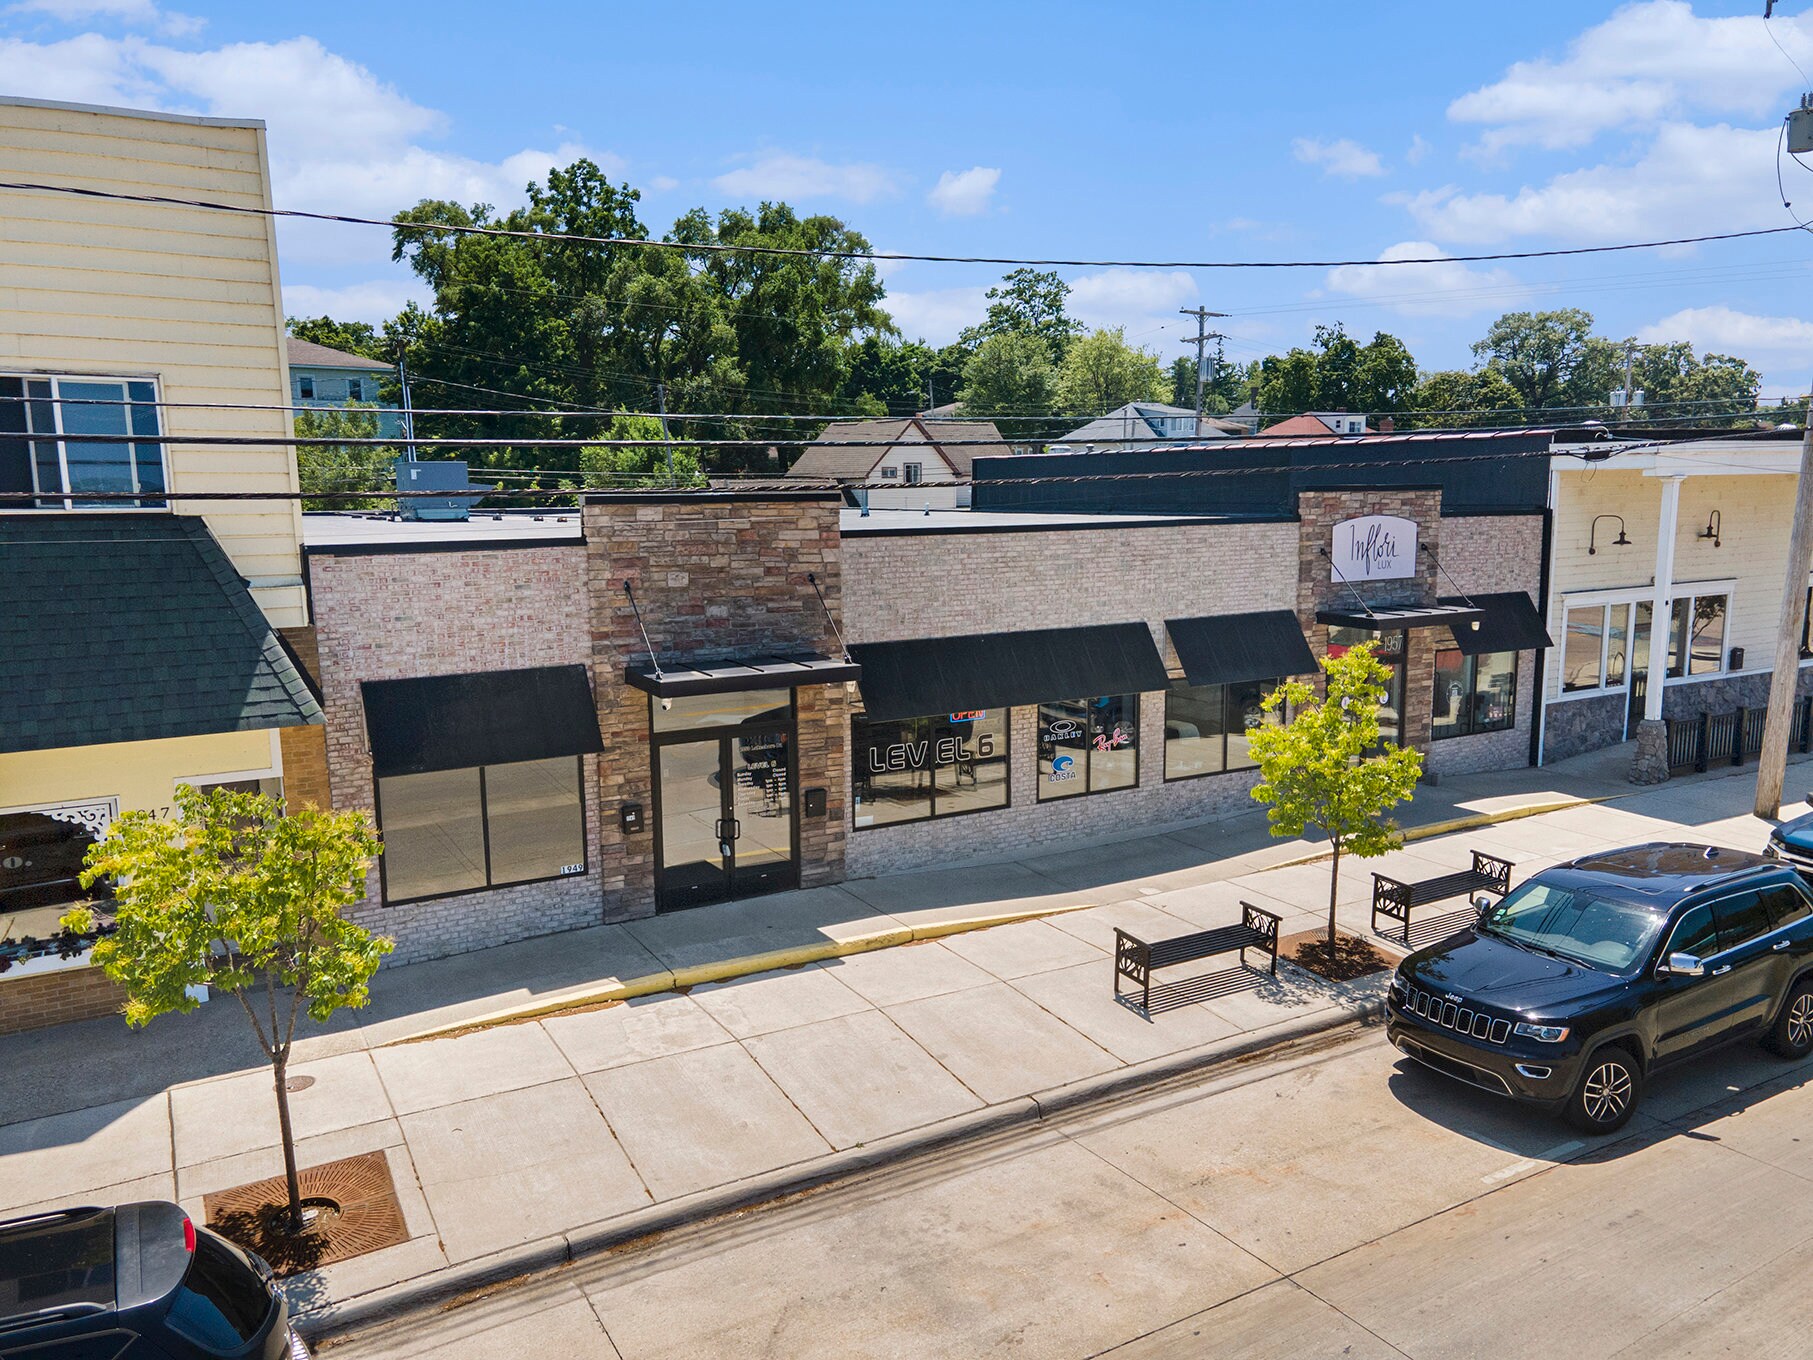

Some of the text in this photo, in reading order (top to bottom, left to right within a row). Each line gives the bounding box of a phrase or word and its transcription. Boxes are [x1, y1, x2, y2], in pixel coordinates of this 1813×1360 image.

[1350, 523, 1399, 576] Inflori
[1377, 560, 1392, 570] LUX
[1384, 635, 1404, 652] 1957
[1043, 730, 1082, 742] OAKLEY
[869, 732, 994, 773] LEVEL 6
[1048, 771, 1076, 783] COSTA
[136, 806, 170, 821] 47
[562, 863, 583, 874] 1949
[1445, 992, 1463, 1003] Jeep
